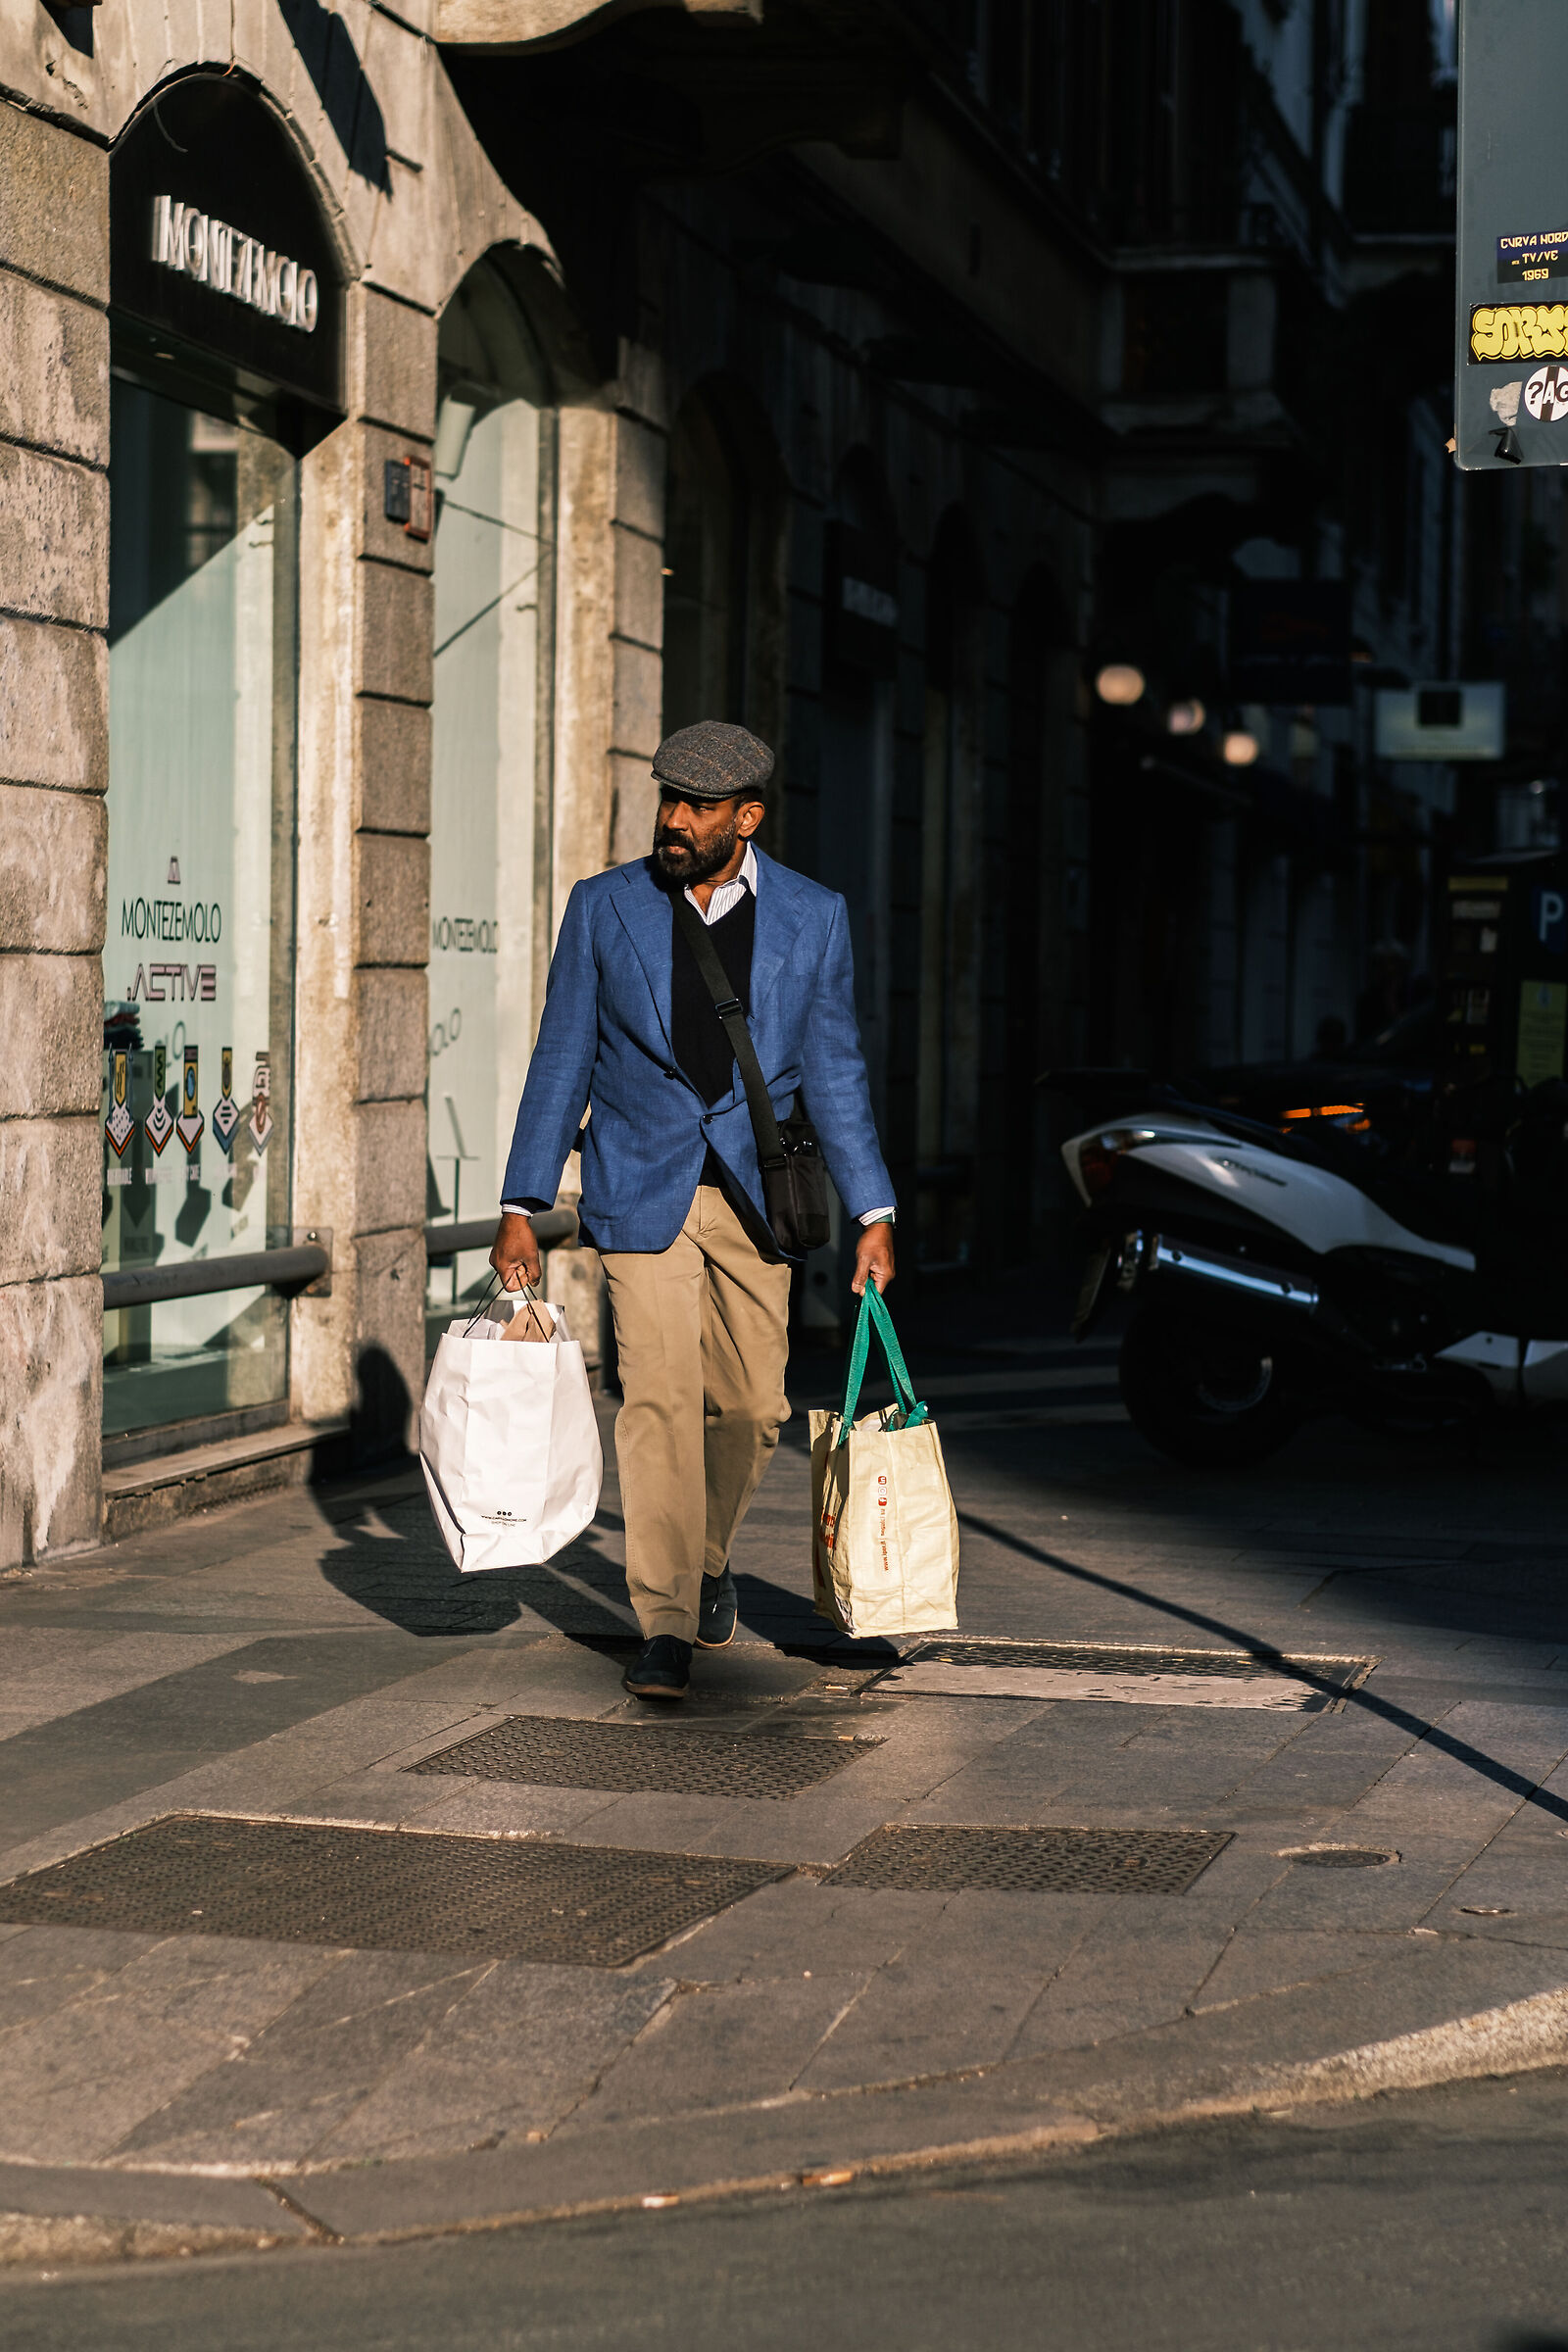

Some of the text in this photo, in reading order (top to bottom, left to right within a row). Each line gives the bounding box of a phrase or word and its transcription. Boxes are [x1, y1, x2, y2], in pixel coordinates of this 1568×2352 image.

[1522, 269, 1549, 281] 1969
[122, 897, 221, 943] MONTEZEMOLO
[1539, 890, 1565, 943] P
